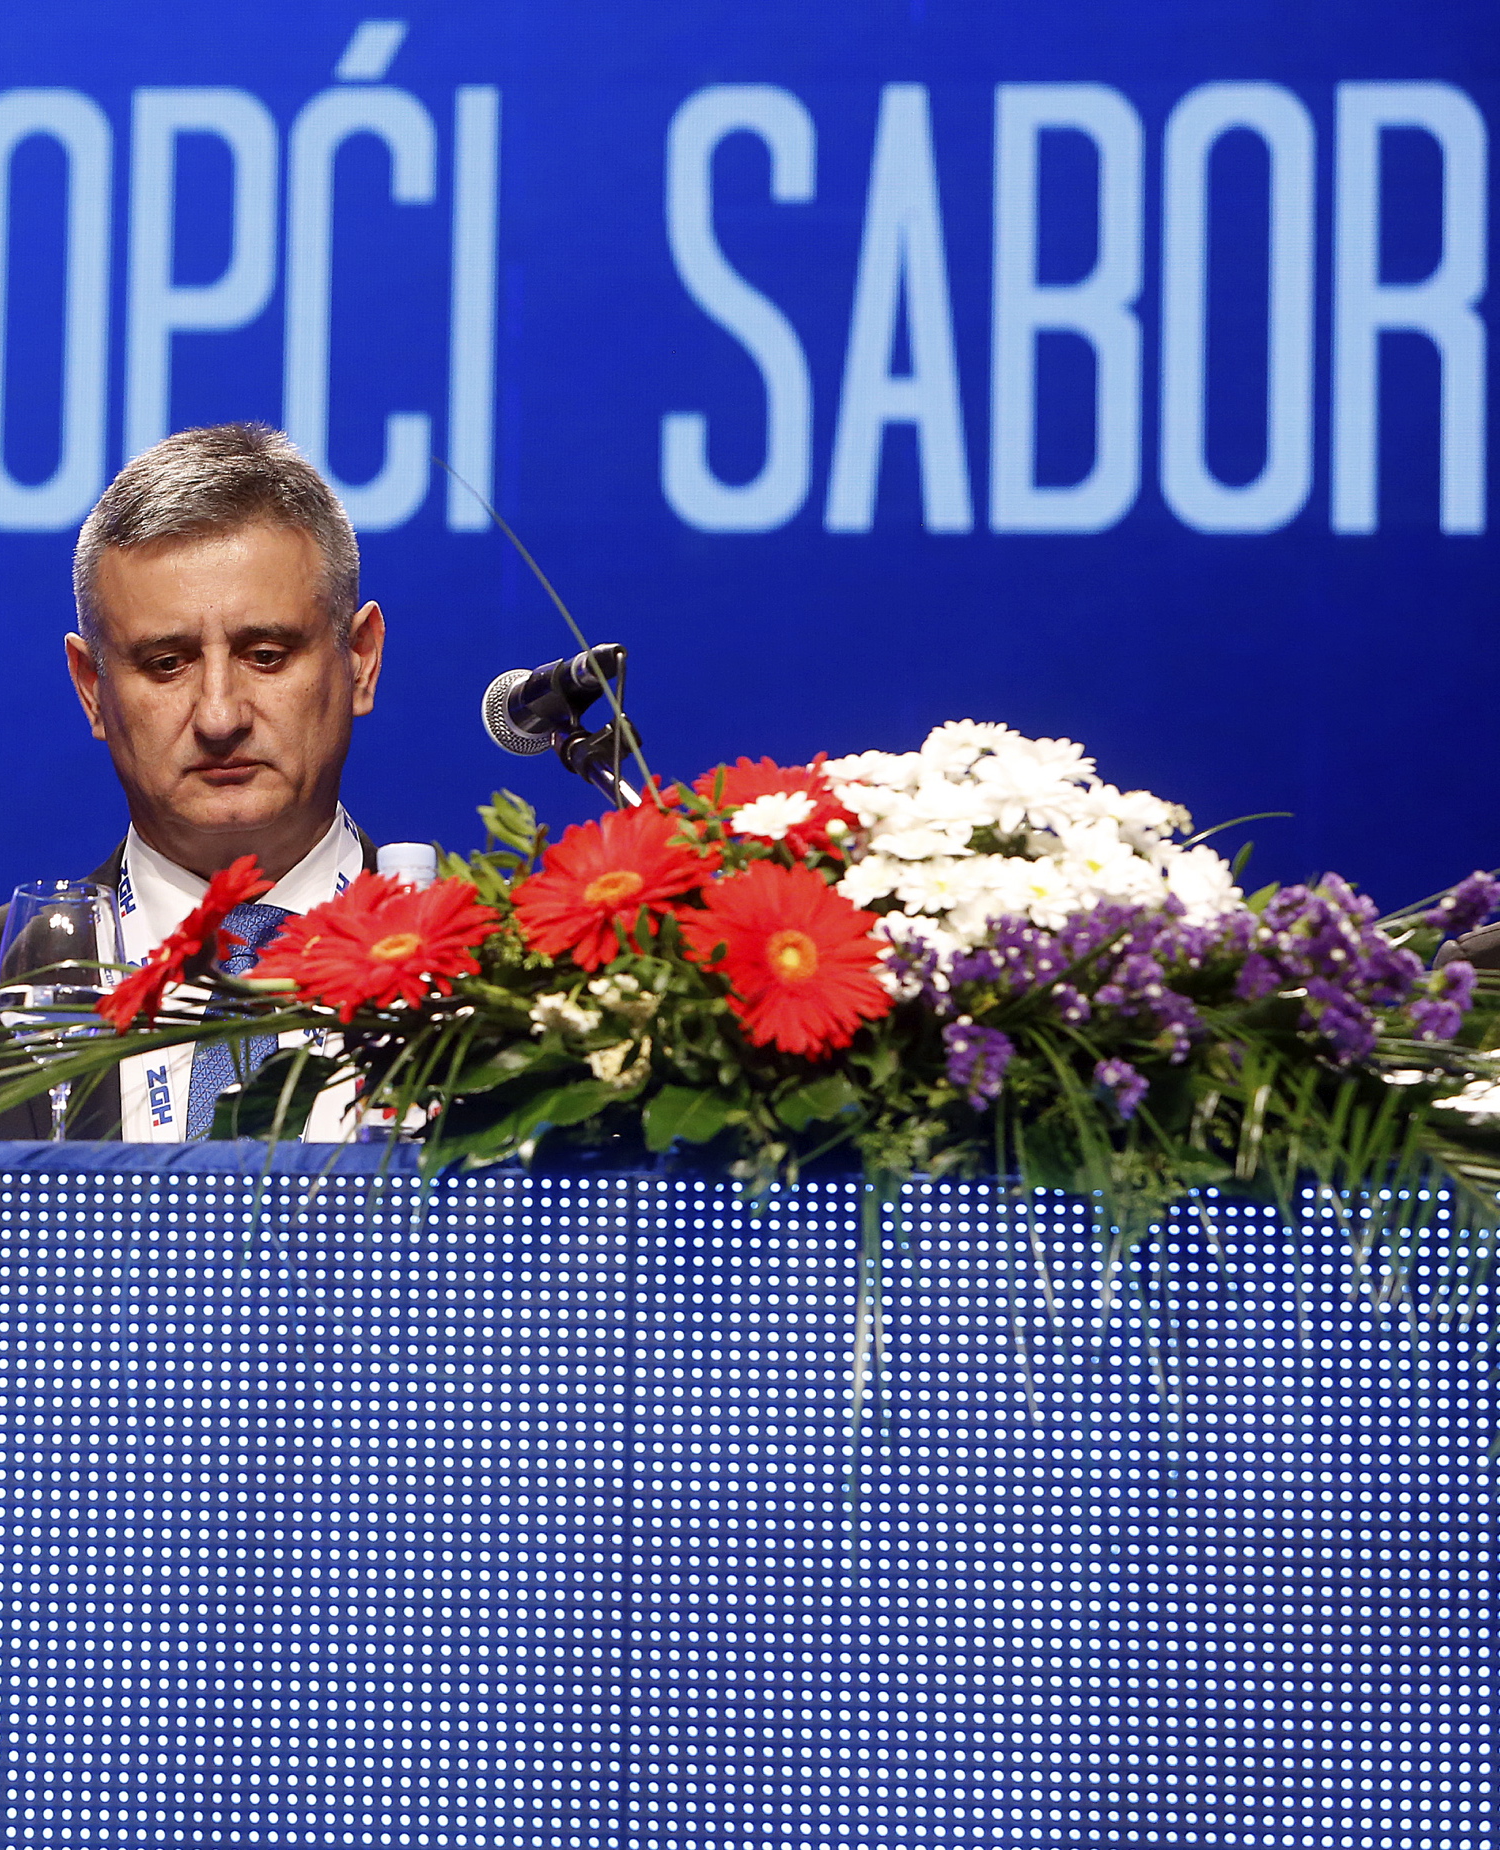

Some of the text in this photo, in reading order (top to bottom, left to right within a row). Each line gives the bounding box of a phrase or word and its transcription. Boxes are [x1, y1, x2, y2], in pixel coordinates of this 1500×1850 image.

[662, 82, 1487, 533] SABOR
[119, 858, 136, 918] HDZ
[146, 1064, 173, 1127] HDZ
